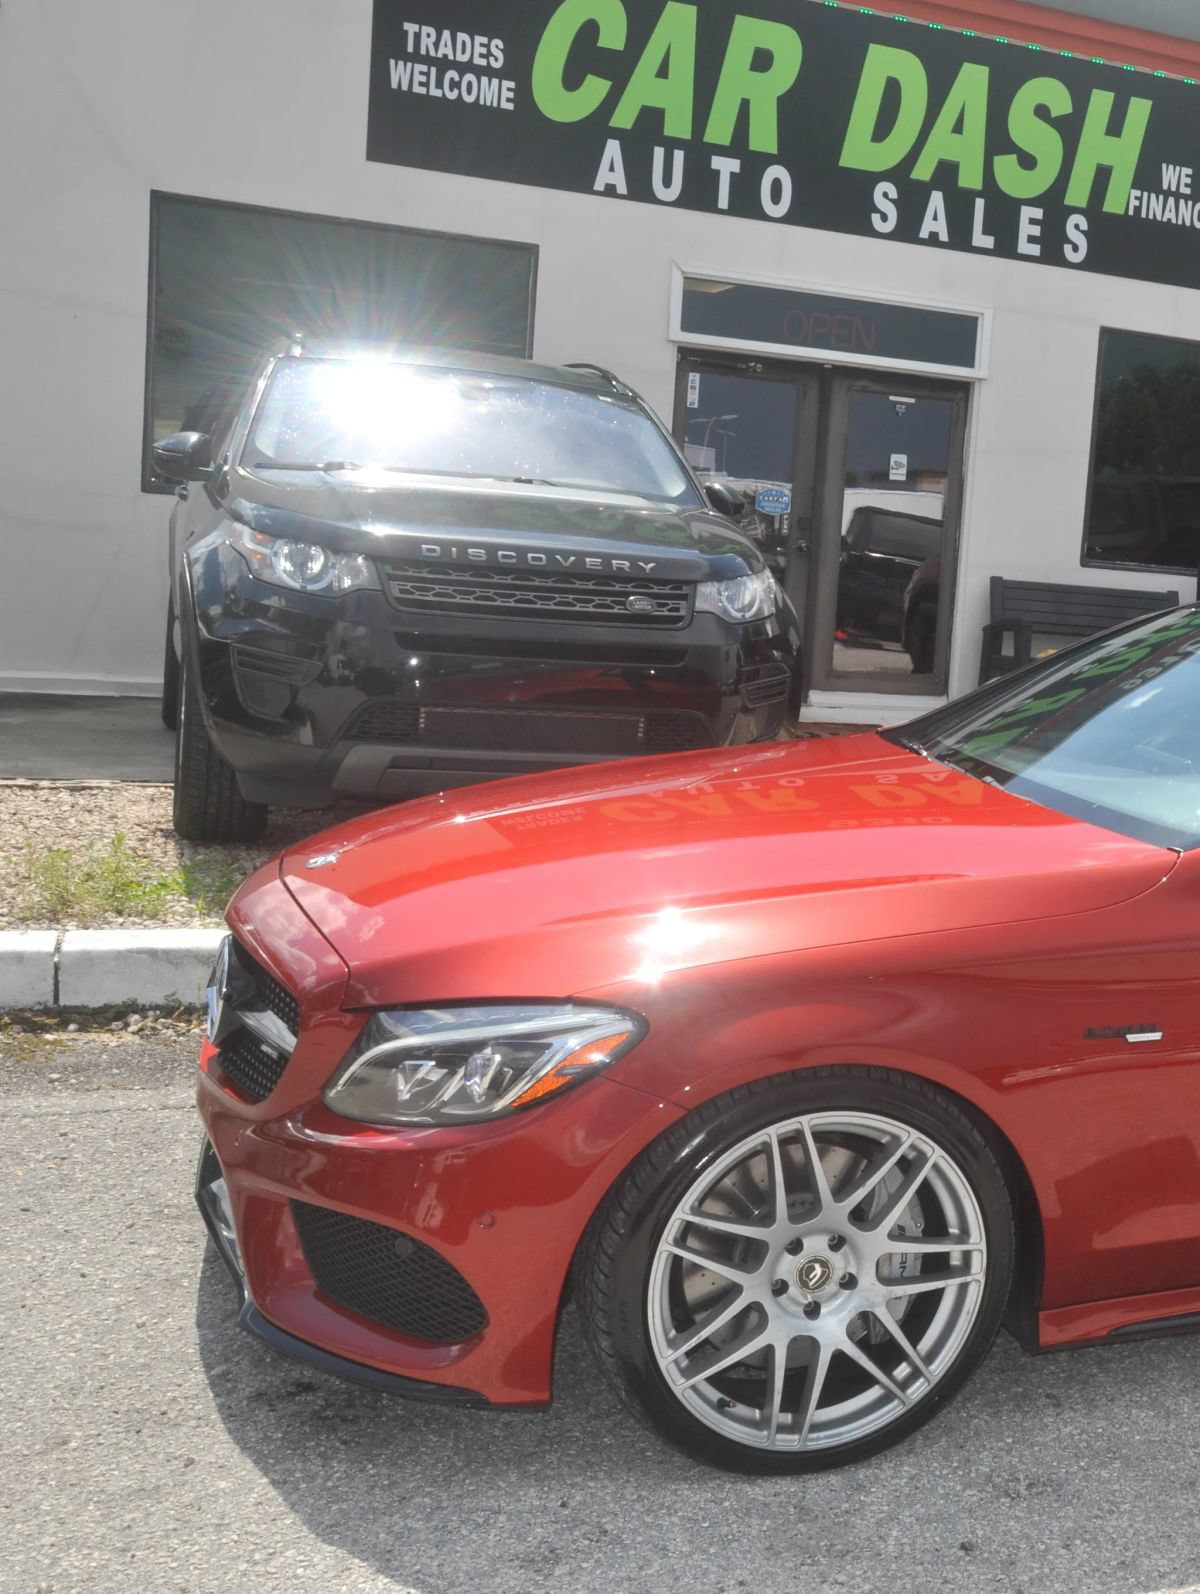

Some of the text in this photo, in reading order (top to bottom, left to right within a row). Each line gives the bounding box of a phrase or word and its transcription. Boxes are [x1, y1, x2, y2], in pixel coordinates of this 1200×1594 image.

[403, 22, 505, 69] TRADES
[389, 58, 516, 110] WELCOME
[531, 0, 1153, 215] CAR DASH
[593, 138, 1089, 263] AUTO SALES
[1161, 163, 1193, 194] WE
[783, 310, 880, 351] OPEN
[421, 544, 657, 573] DISCOVERY
